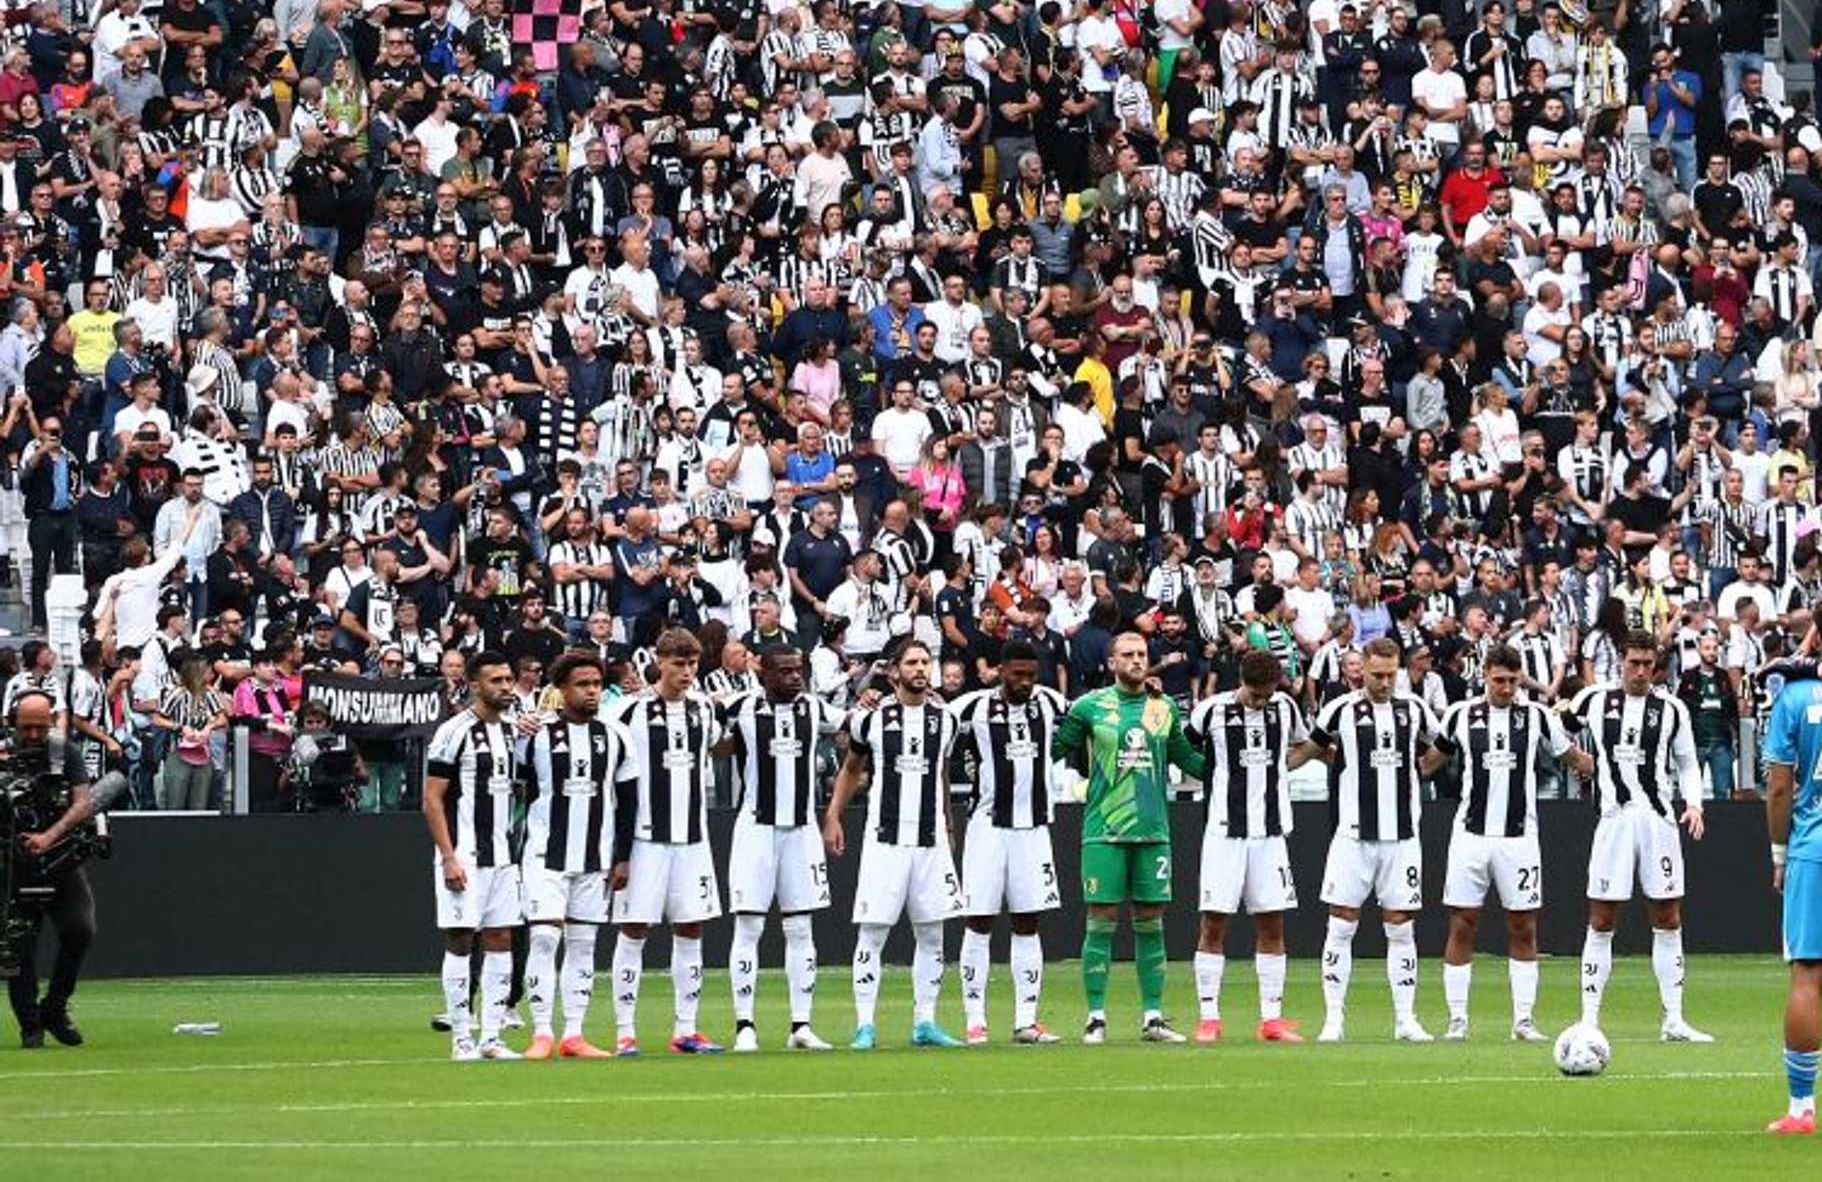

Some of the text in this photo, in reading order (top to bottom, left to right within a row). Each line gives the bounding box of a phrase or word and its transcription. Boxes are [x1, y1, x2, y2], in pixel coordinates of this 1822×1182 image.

[1406, 865, 1420, 889] 8
[1517, 865, 1540, 892] 27
[1660, 855, 1673, 878] 9
